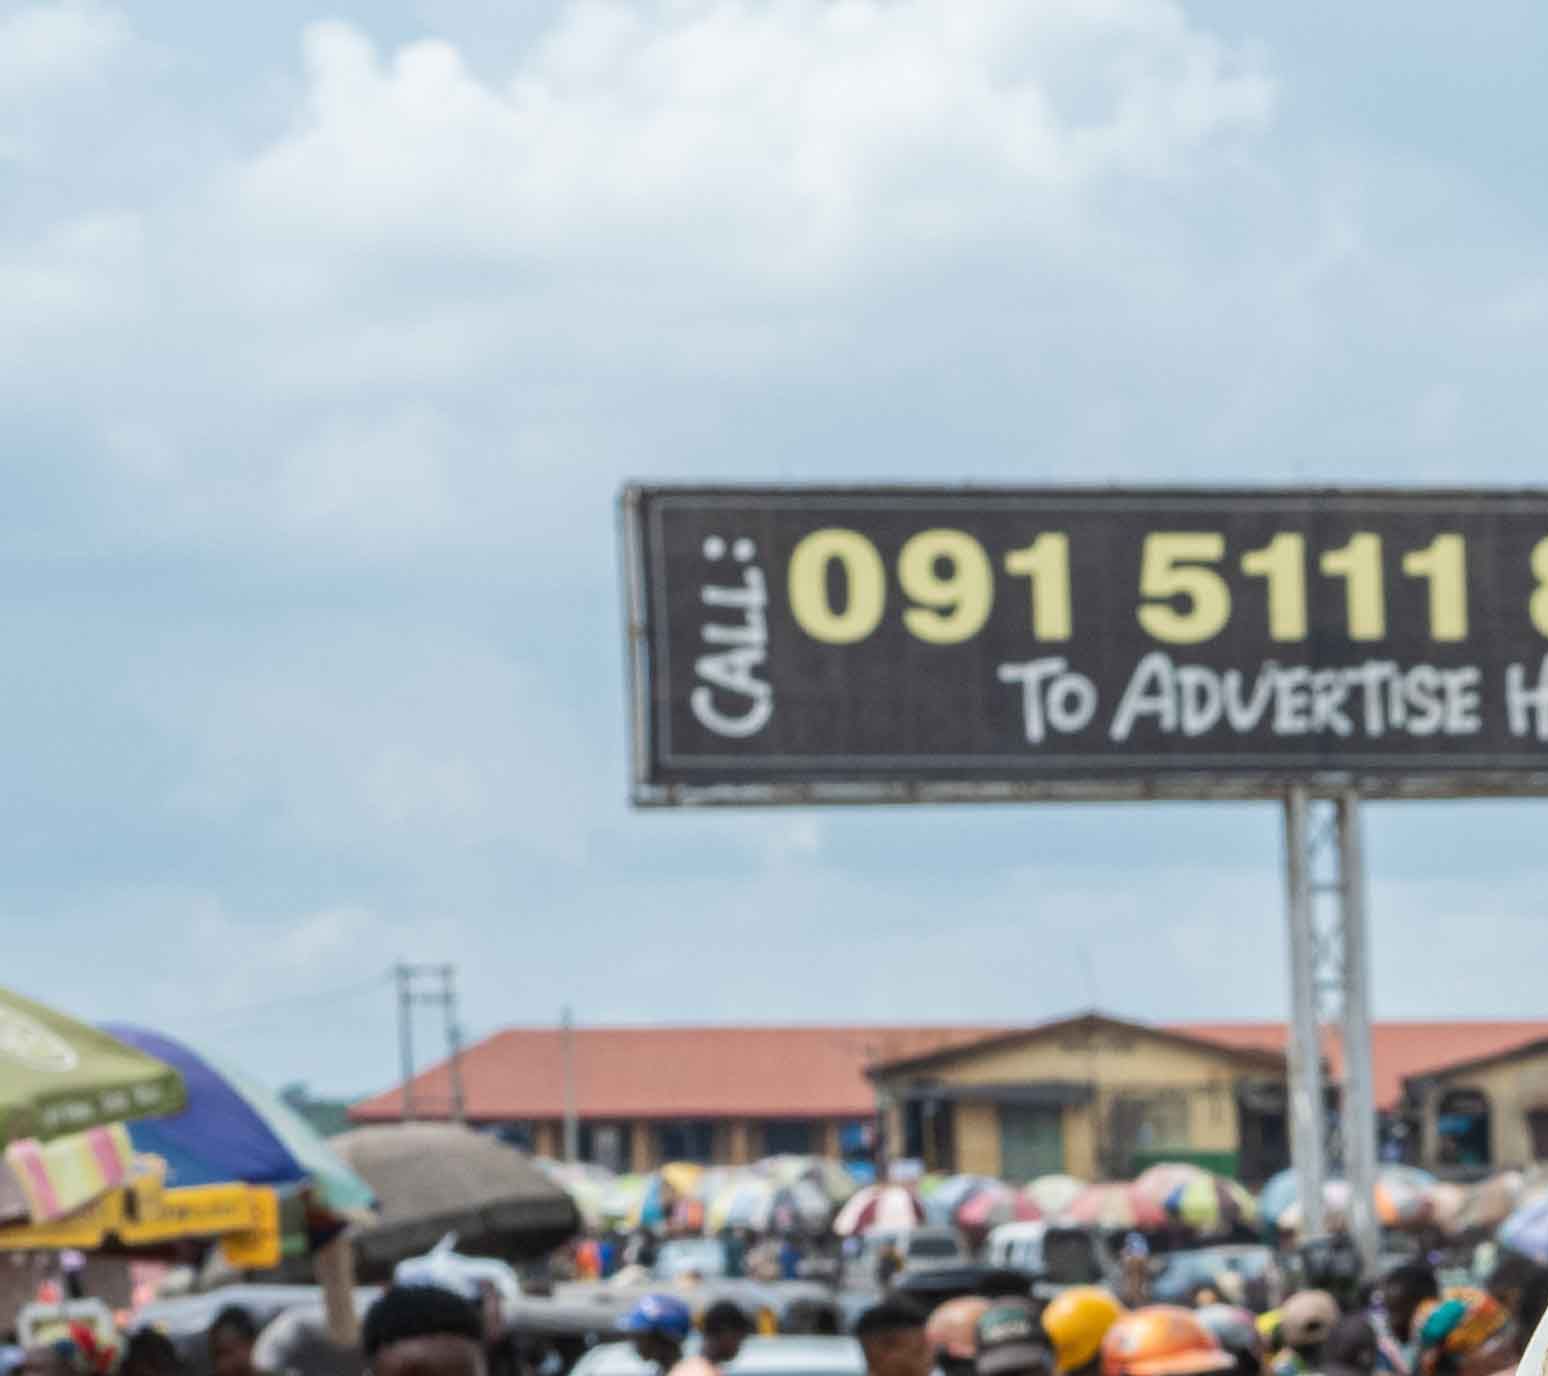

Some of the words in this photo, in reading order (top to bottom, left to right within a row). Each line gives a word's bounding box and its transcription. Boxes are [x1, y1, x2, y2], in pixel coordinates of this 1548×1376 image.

[690, 534, 775, 739] CALL:
[787, 527, 1073, 645] 091
[1136, 531, 1470, 645] 5111
